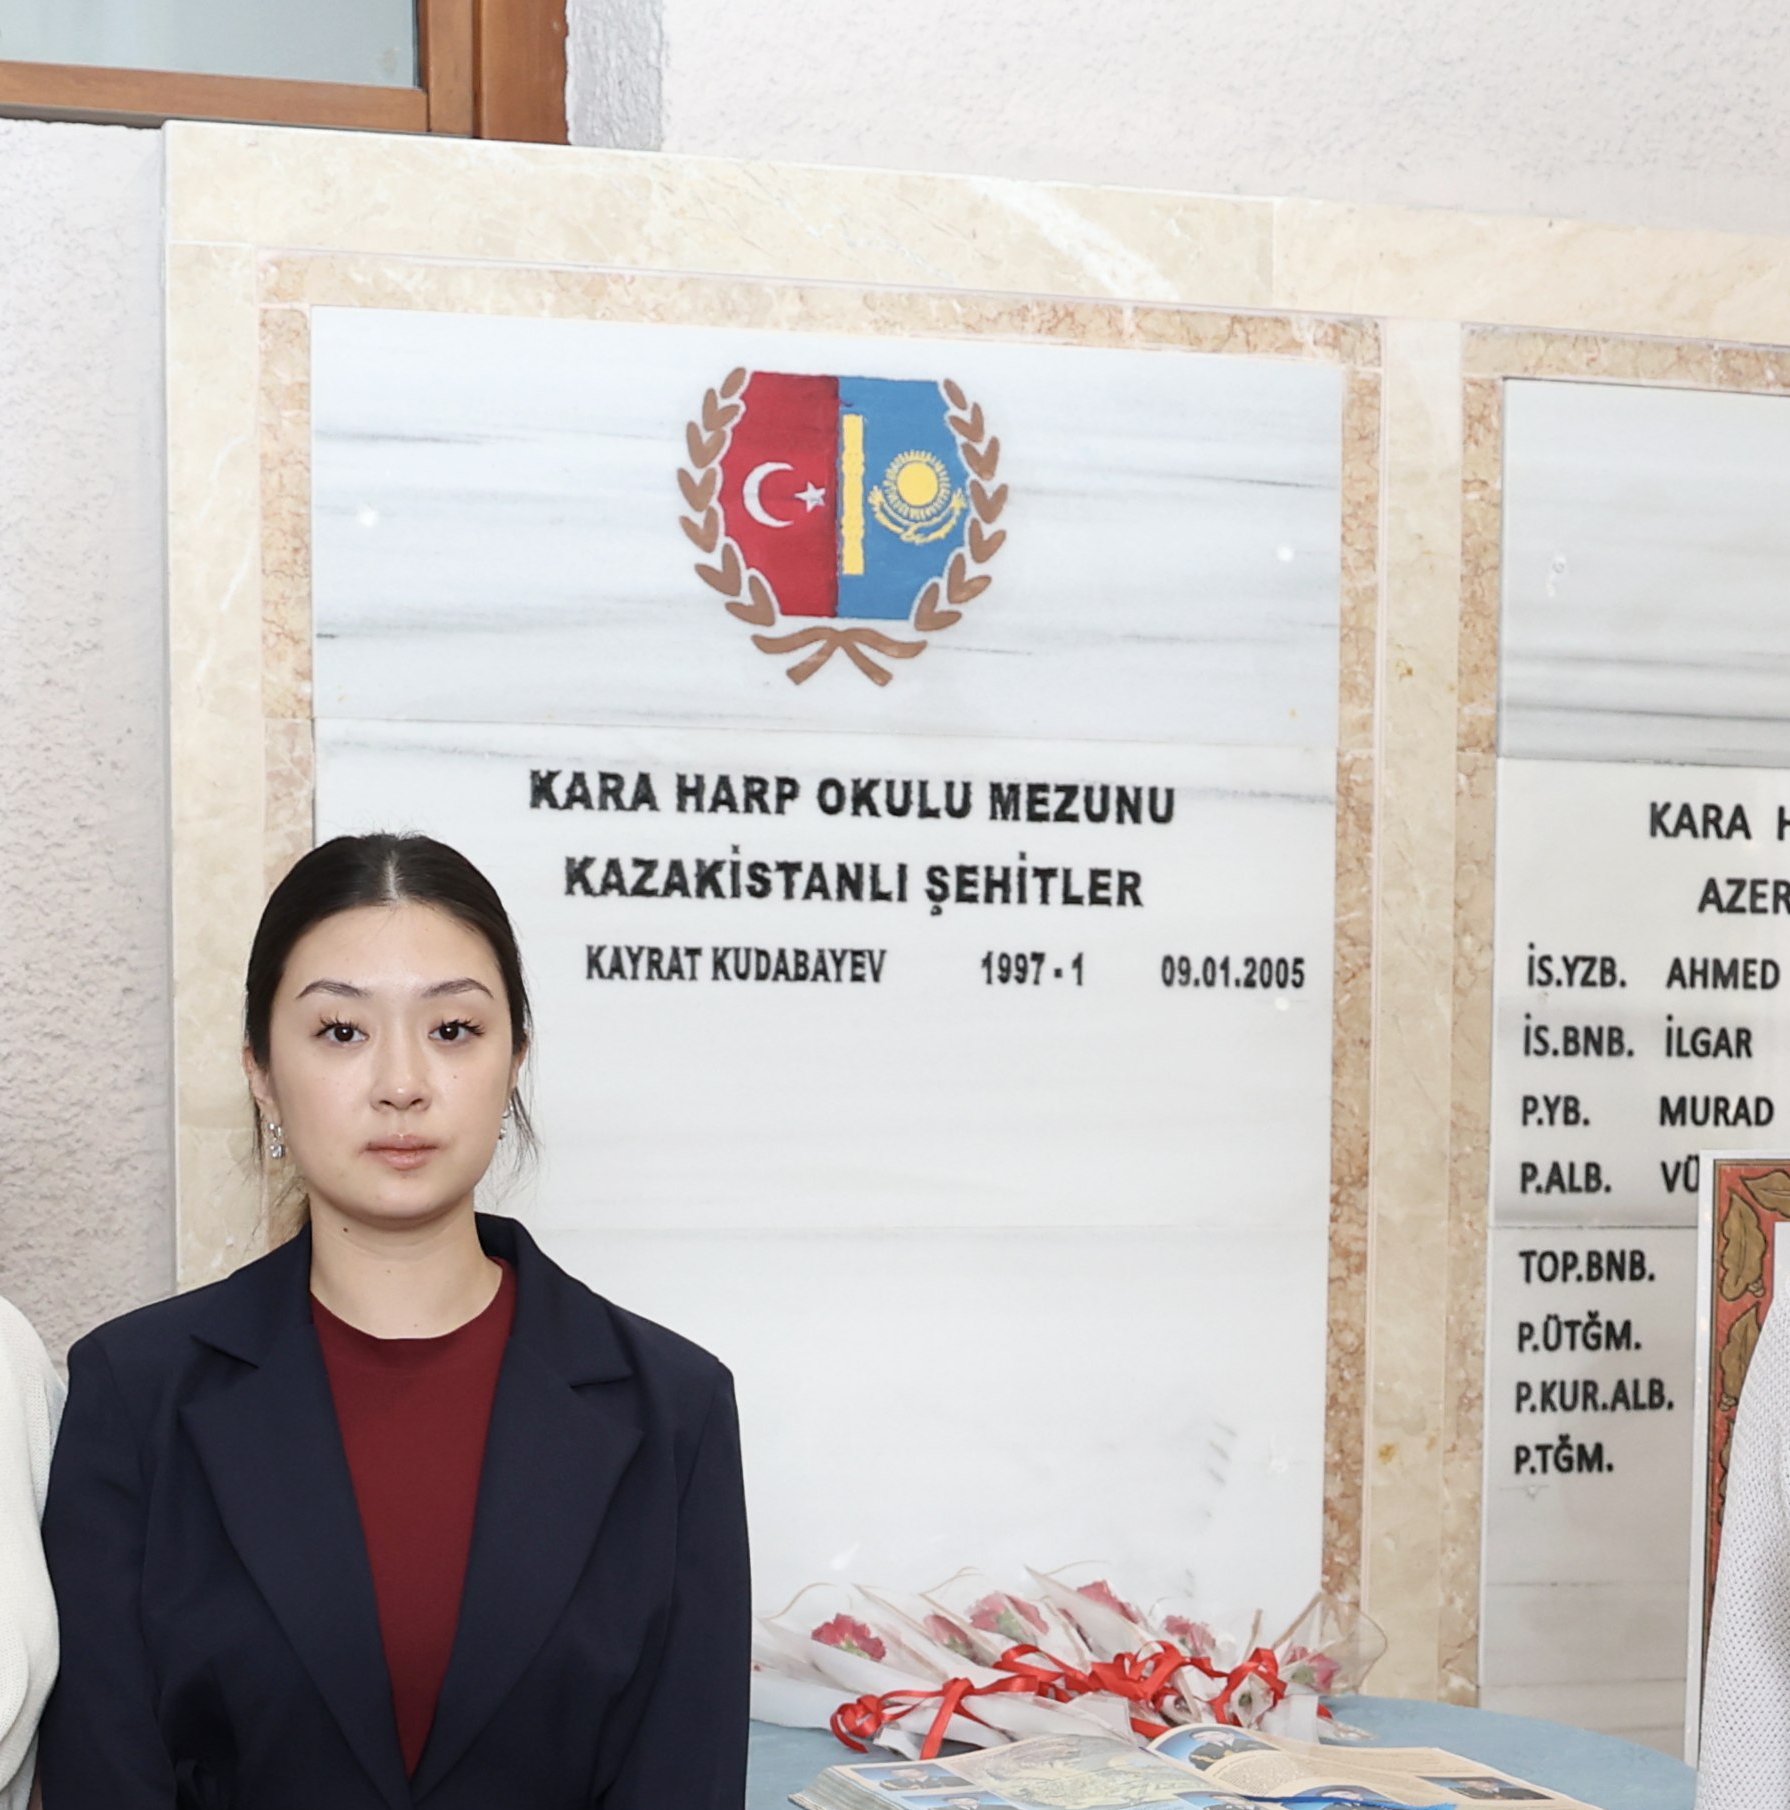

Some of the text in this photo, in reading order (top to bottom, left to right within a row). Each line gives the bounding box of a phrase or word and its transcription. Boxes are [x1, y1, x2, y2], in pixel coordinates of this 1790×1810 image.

[530, 770, 1174, 824] KARA HARP OKULU MEZUNU
[1650, 802, 1751, 840] KARA
[565, 845, 1143, 916] KAZAKİSTANLI ŞEHİTLER
[587, 945, 702, 981] KAYRAT
[712, 947, 886, 983] KUDABAYEV
[982, 951, 1045, 985] 1997
[1072, 953, 1083, 986] 1
[1162, 955, 1304, 989] 09.01.2005
[1528, 943, 1626, 988] İS.YZB.
[1666, 957, 1780, 990] AHMED
[1523, 1013, 1635, 1058] İS.BNB.
[1665, 1013, 1752, 1059] İLGAR
[1522, 1095, 1590, 1126] P.YB.
[1660, 1096, 1774, 1126] MURAD
[1521, 1161, 1611, 1194] P.ALB.
[1519, 1249, 1655, 1283] TOP.BNB.
[1518, 1314, 1641, 1352] P.ÜTĞM.
[1516, 1378, 1674, 1413] P.KUR.ALB.
[1515, 1434, 1613, 1474] P.TĞM.
